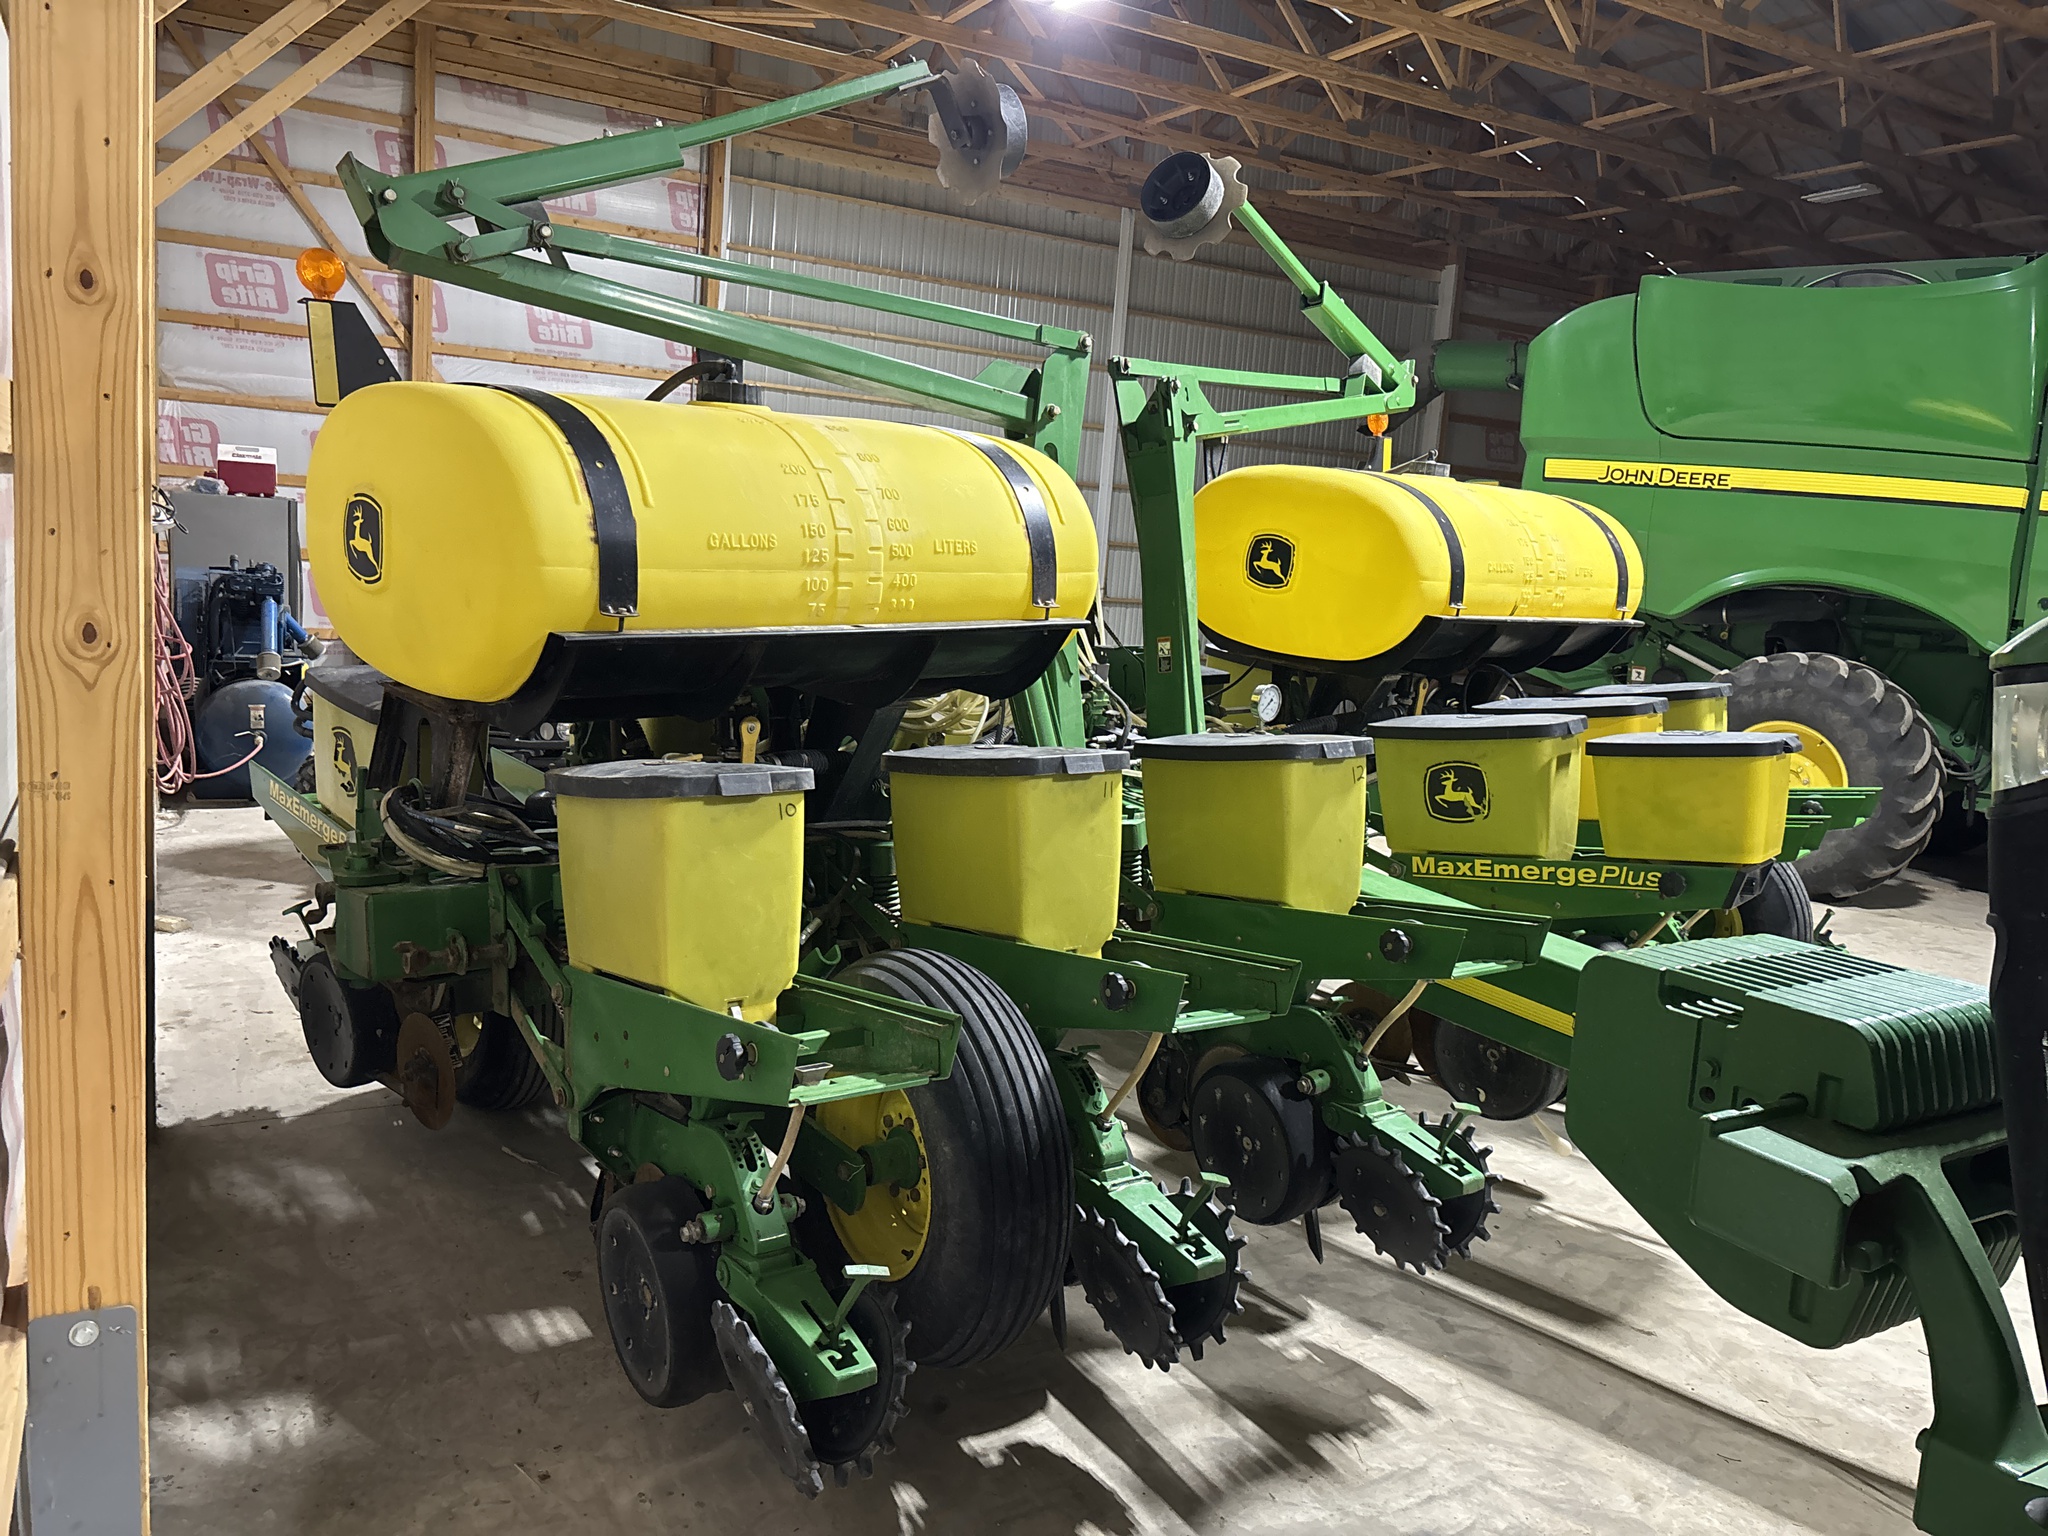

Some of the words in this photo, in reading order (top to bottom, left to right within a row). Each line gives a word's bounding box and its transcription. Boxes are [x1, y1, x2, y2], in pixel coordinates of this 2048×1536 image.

[781, 463, 807, 476] 200
[1598, 465, 1654, 483] JOHN
[1659, 468, 1731, 487] DEERE
[793, 494, 820, 508] 175
[876, 487, 900, 501] 700
[801, 522, 827, 539] 150
[887, 518, 910, 532] 600
[708, 531, 778, 551] GALLONS
[933, 538, 979, 556] LITERS
[803, 548, 830, 564] 125
[889, 543, 914, 559] 500
[805, 576, 829, 592] 100
[892, 573, 918, 588] 400
[1352, 765, 1365, 784] 12
[269, 779, 347, 844] MaxEmergeP
[779, 803, 797, 820] 10
